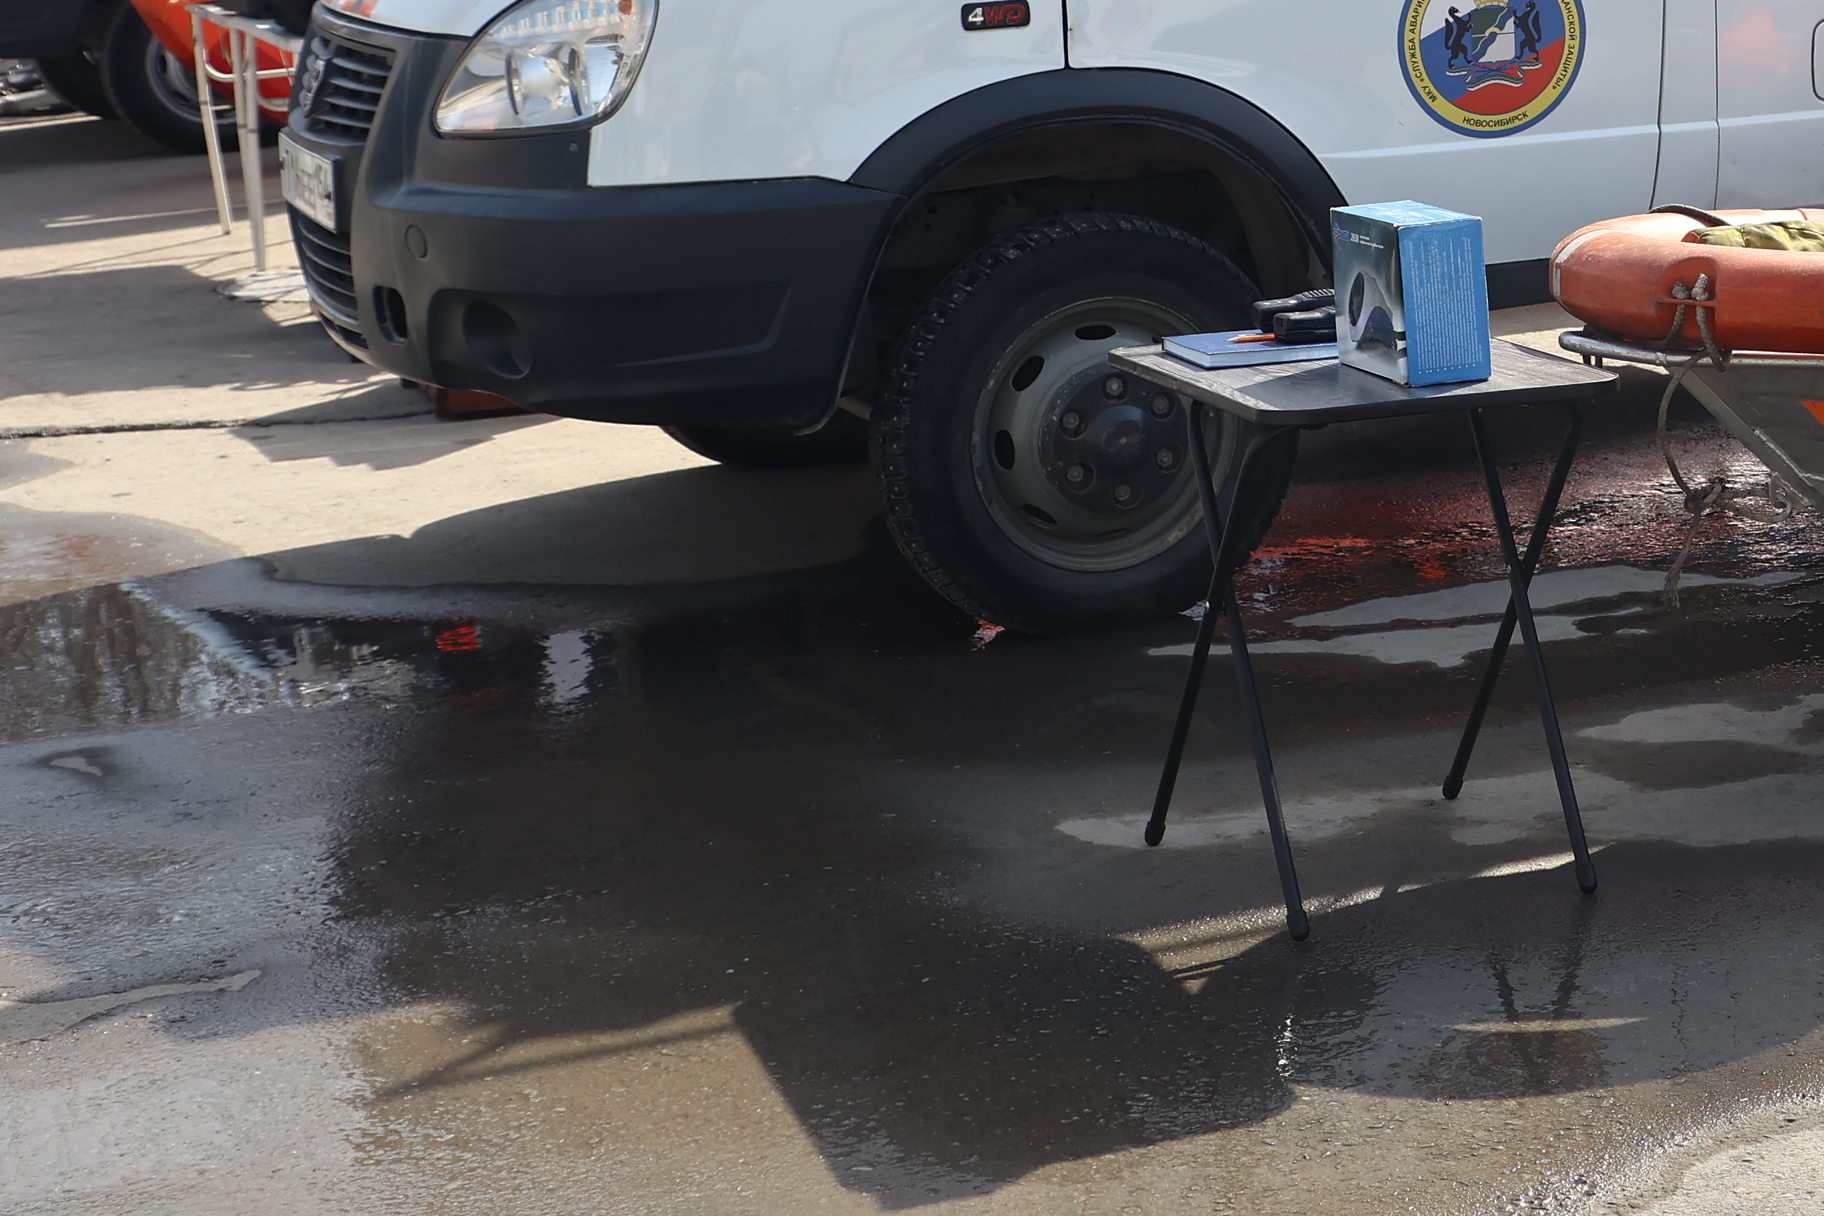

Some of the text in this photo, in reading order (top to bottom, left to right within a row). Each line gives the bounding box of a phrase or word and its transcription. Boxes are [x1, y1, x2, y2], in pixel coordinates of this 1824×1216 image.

[968, 4, 1025, 25] 4WD
[1421, 85, 1437, 103] МКУ
[1462, 110, 1529, 128] НОВОСИБИРСК
